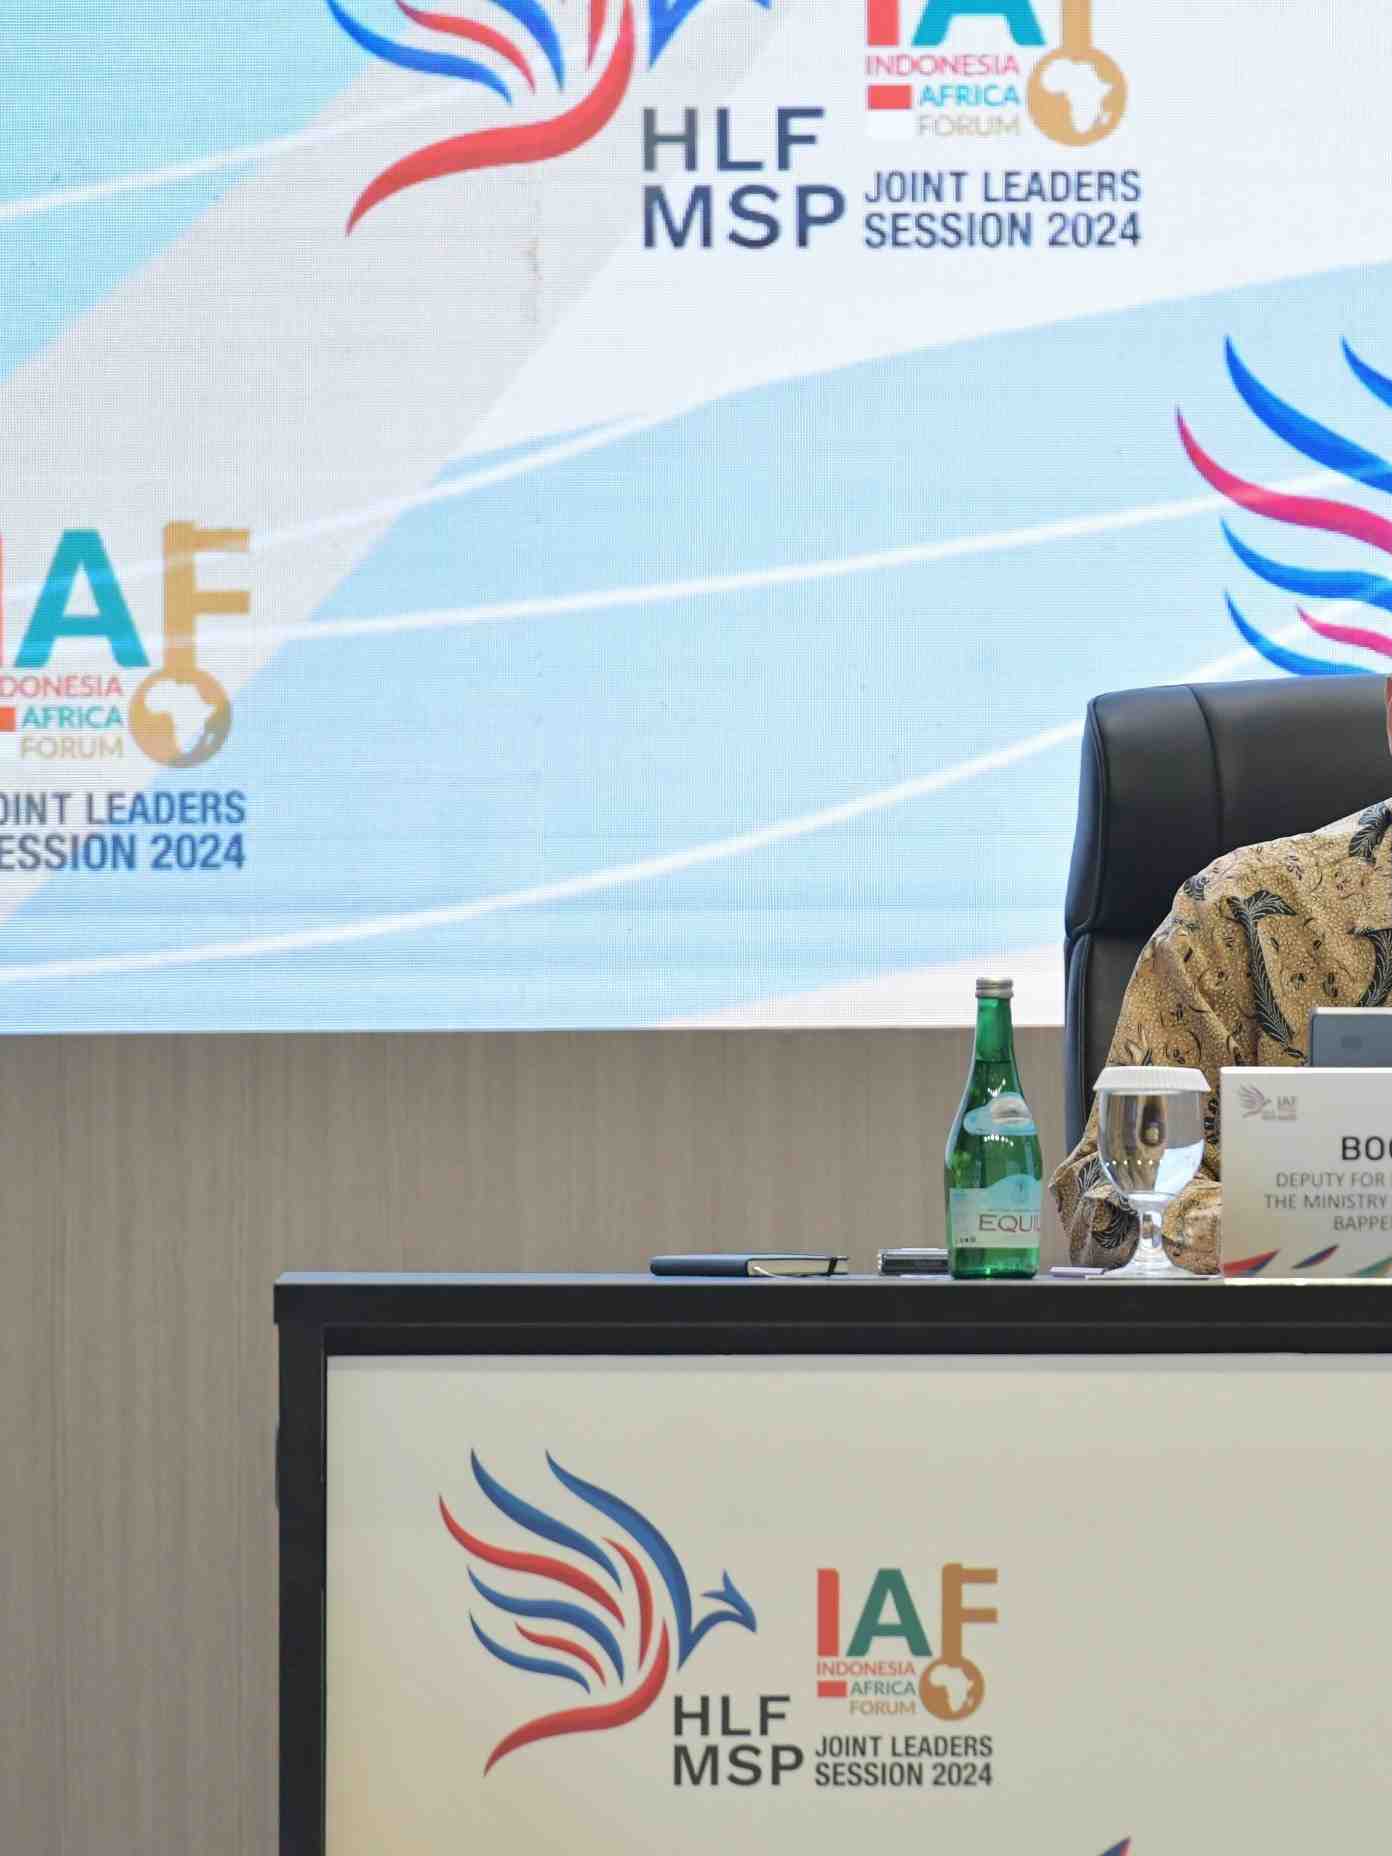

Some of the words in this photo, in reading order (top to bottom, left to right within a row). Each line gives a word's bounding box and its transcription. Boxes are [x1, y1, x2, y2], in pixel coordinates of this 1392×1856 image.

[866, 54, 1020, 77] INDONESIA
[919, 85, 1020, 107] AFRICA
[919, 115, 1020, 137] FORUM
[643, 107, 825, 171] HLF
[866, 171, 968, 202] JOINT
[984, 169, 1141, 202] LEADERS
[643, 184, 845, 248] MSP
[866, 213, 1031, 248] SESSION
[1049, 213, 1141, 247] 2024
[0, 521, 250, 668] AF
[22, 705, 122, 730] AFRICA
[21, 736, 123, 759] FORUM
[87, 790, 246, 826] LEADERS
[151, 833, 246, 871] 2024
[1276, 1172, 1345, 1188] DEPUTY
[1351, 1172, 1385, 1188] FOR
[1265, 1193, 1296, 1209] THE
[1304, 1193, 1386, 1209] MINISTRY
[817, 1563, 998, 1657] IAF
[817, 1661, 916, 1676] INDONESIA
[850, 1681, 916, 1696] AFRICA
[674, 1695, 791, 1736] HLF
[850, 1700, 916, 1715] FORUM
[815, 1736, 882, 1758] JOINT
[892, 1736, 993, 1758] LEADERS
[674, 1744, 804, 1786] MSP
[815, 1763, 923, 1786] SESSION
[932, 1763, 993, 1786] 2024
